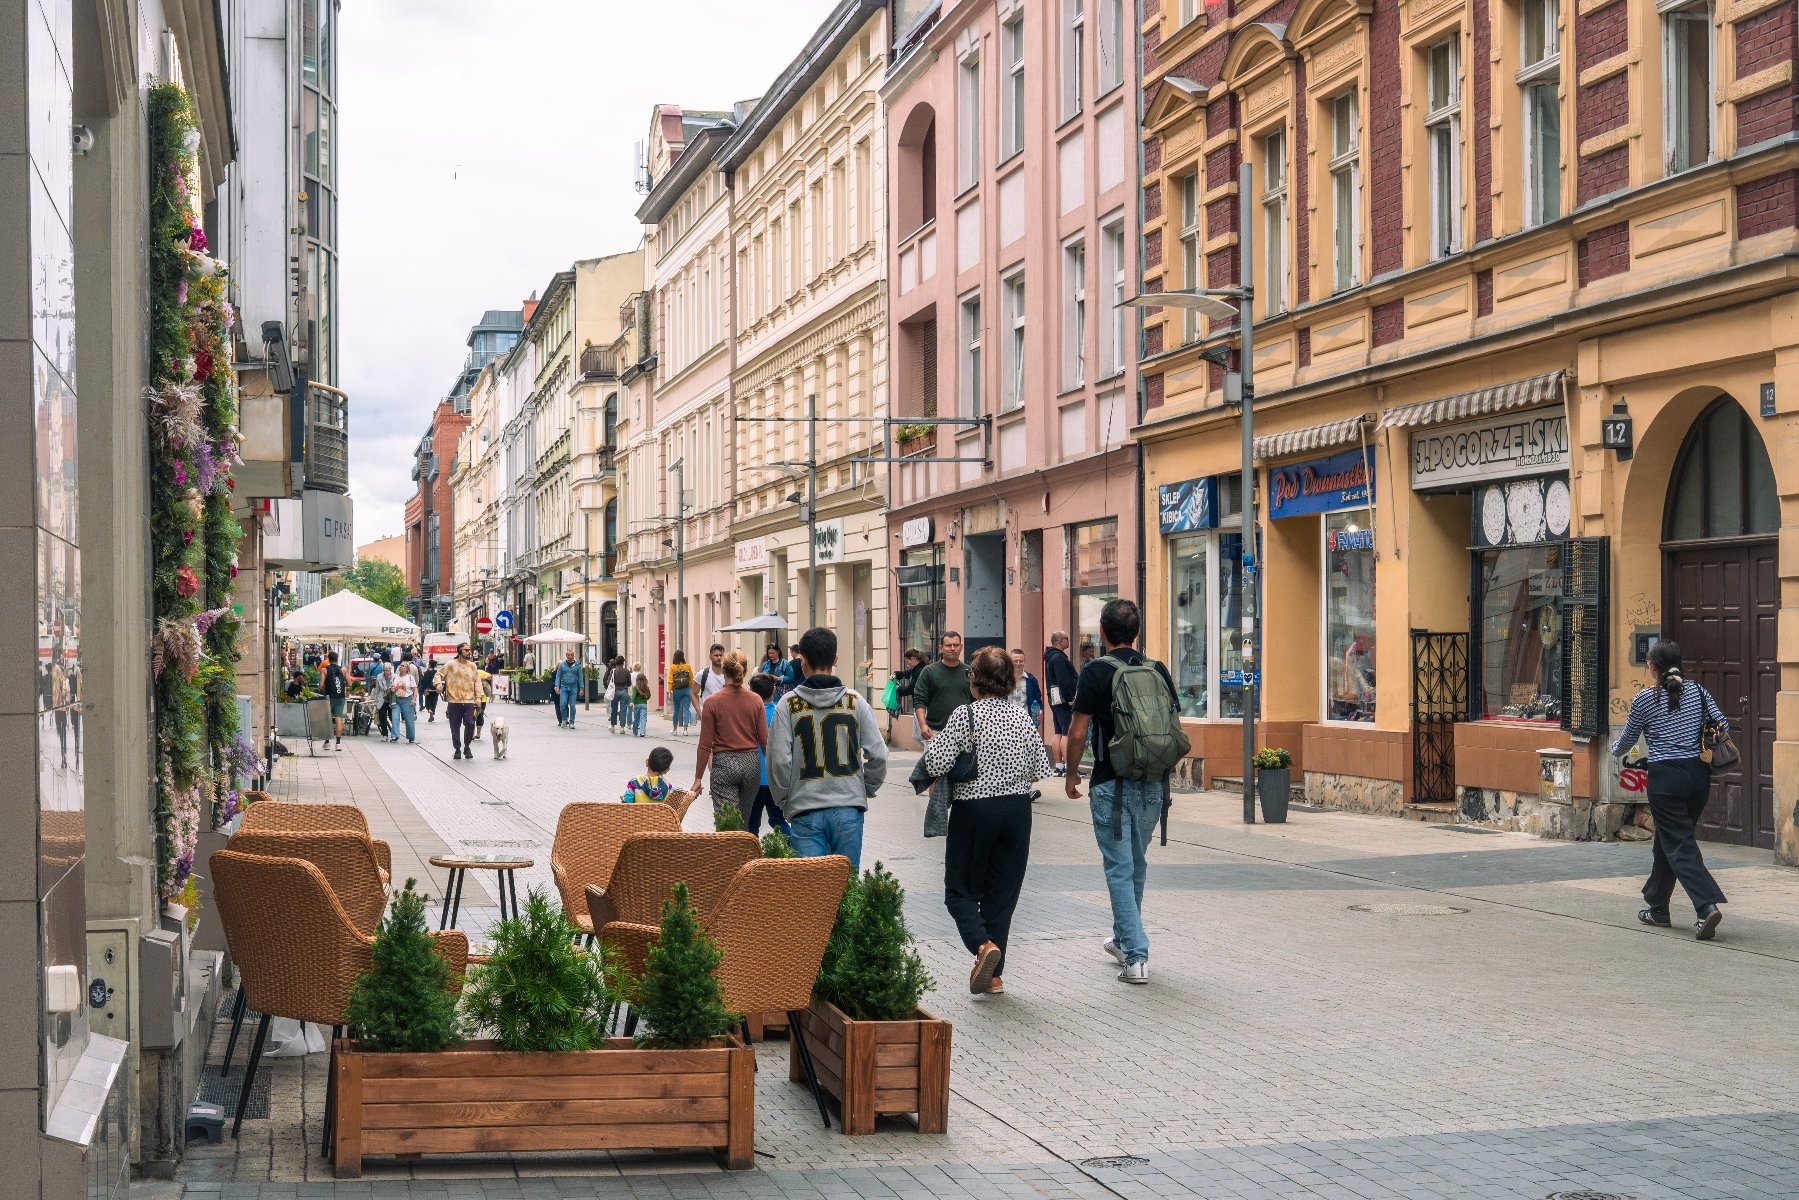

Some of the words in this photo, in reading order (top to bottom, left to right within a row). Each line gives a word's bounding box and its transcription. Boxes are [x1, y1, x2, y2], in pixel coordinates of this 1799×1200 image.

[1605, 422, 1626, 444] 12
[1161, 491, 1181, 506] SKLEP
[1273, 471, 1300, 510] Pod
[1162, 509, 1183, 525] KIBICA
[381, 626, 414, 635] PEPSI
[793, 713, 860, 780] 10
